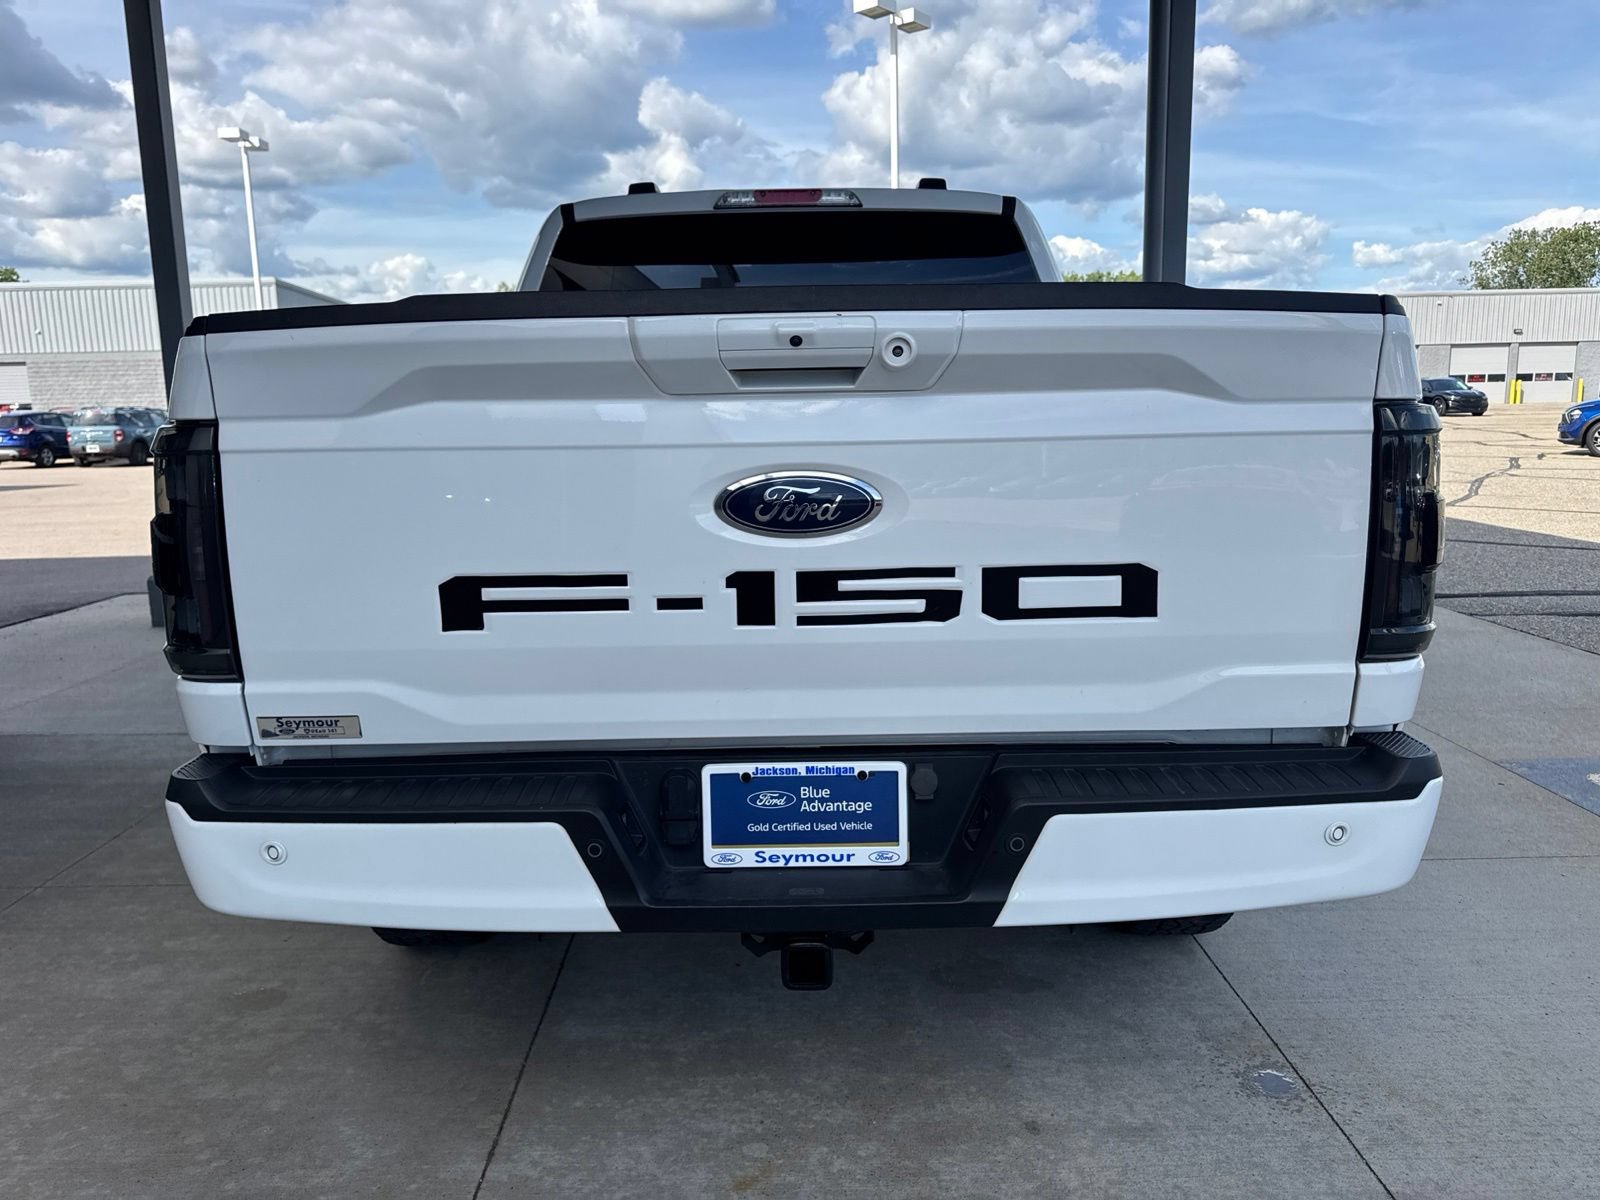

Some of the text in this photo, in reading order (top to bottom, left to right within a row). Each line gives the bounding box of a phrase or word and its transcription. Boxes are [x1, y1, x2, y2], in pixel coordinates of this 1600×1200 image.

[754, 485, 843, 523] Ford
[438, 562, 1160, 632] F-150
[275, 718, 340, 730] Seymour
[752, 765, 855, 776] Jackson, Michigan
[756, 792, 787, 806] Ford
[800, 786, 830, 798] Blue
[800, 800, 873, 814] Advantage
[747, 821, 873, 832] Gold Certified Used Vehicle
[754, 851, 856, 866] Seymour
